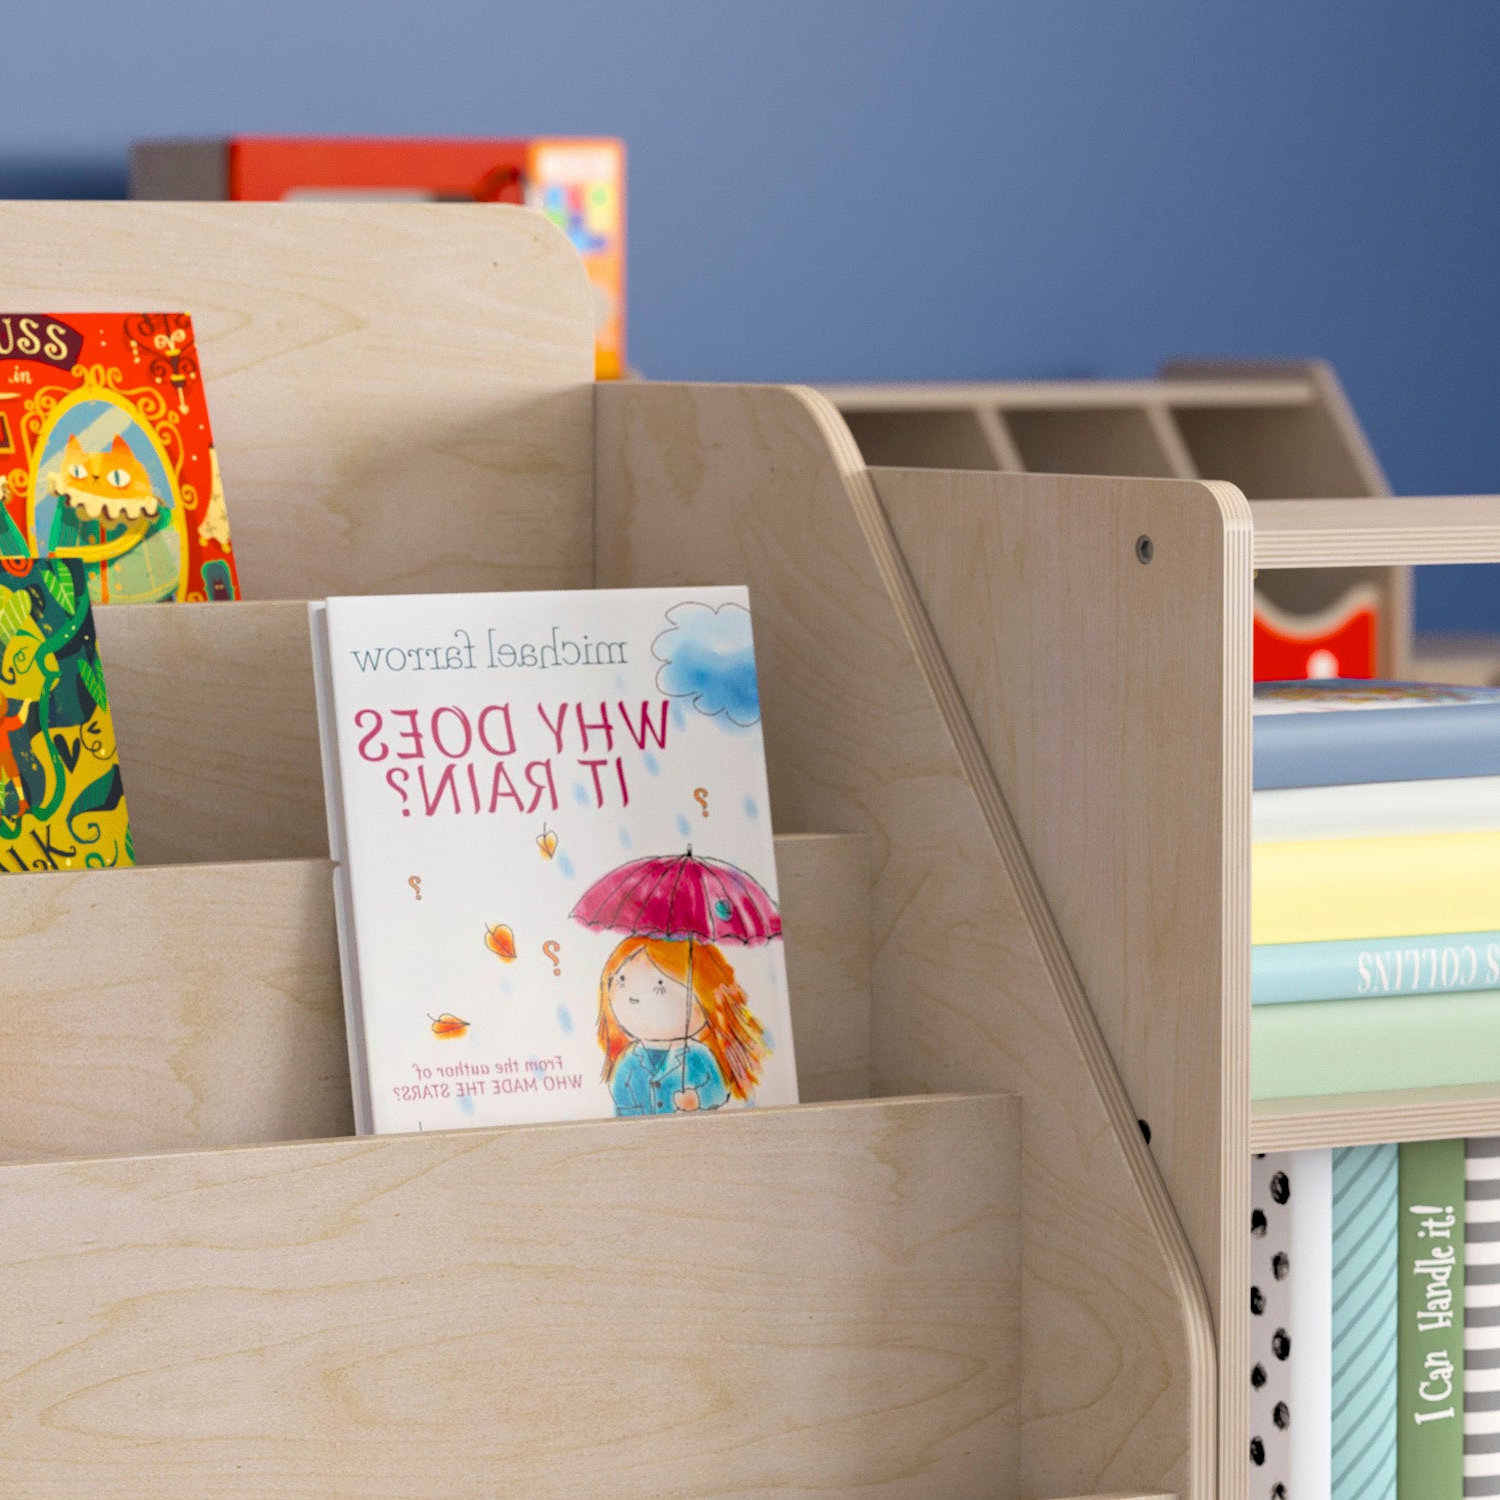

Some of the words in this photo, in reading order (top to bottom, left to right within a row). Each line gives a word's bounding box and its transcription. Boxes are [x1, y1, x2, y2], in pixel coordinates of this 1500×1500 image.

[7, 364, 33, 385] in
[1357, 946, 1478, 993] COLLINS
[1409, 1205, 1456, 1239] it!
[1413, 1245, 1456, 1332] Handle
[1418, 1350, 1455, 1402] Can
[1414, 1406, 1455, 1425] I
